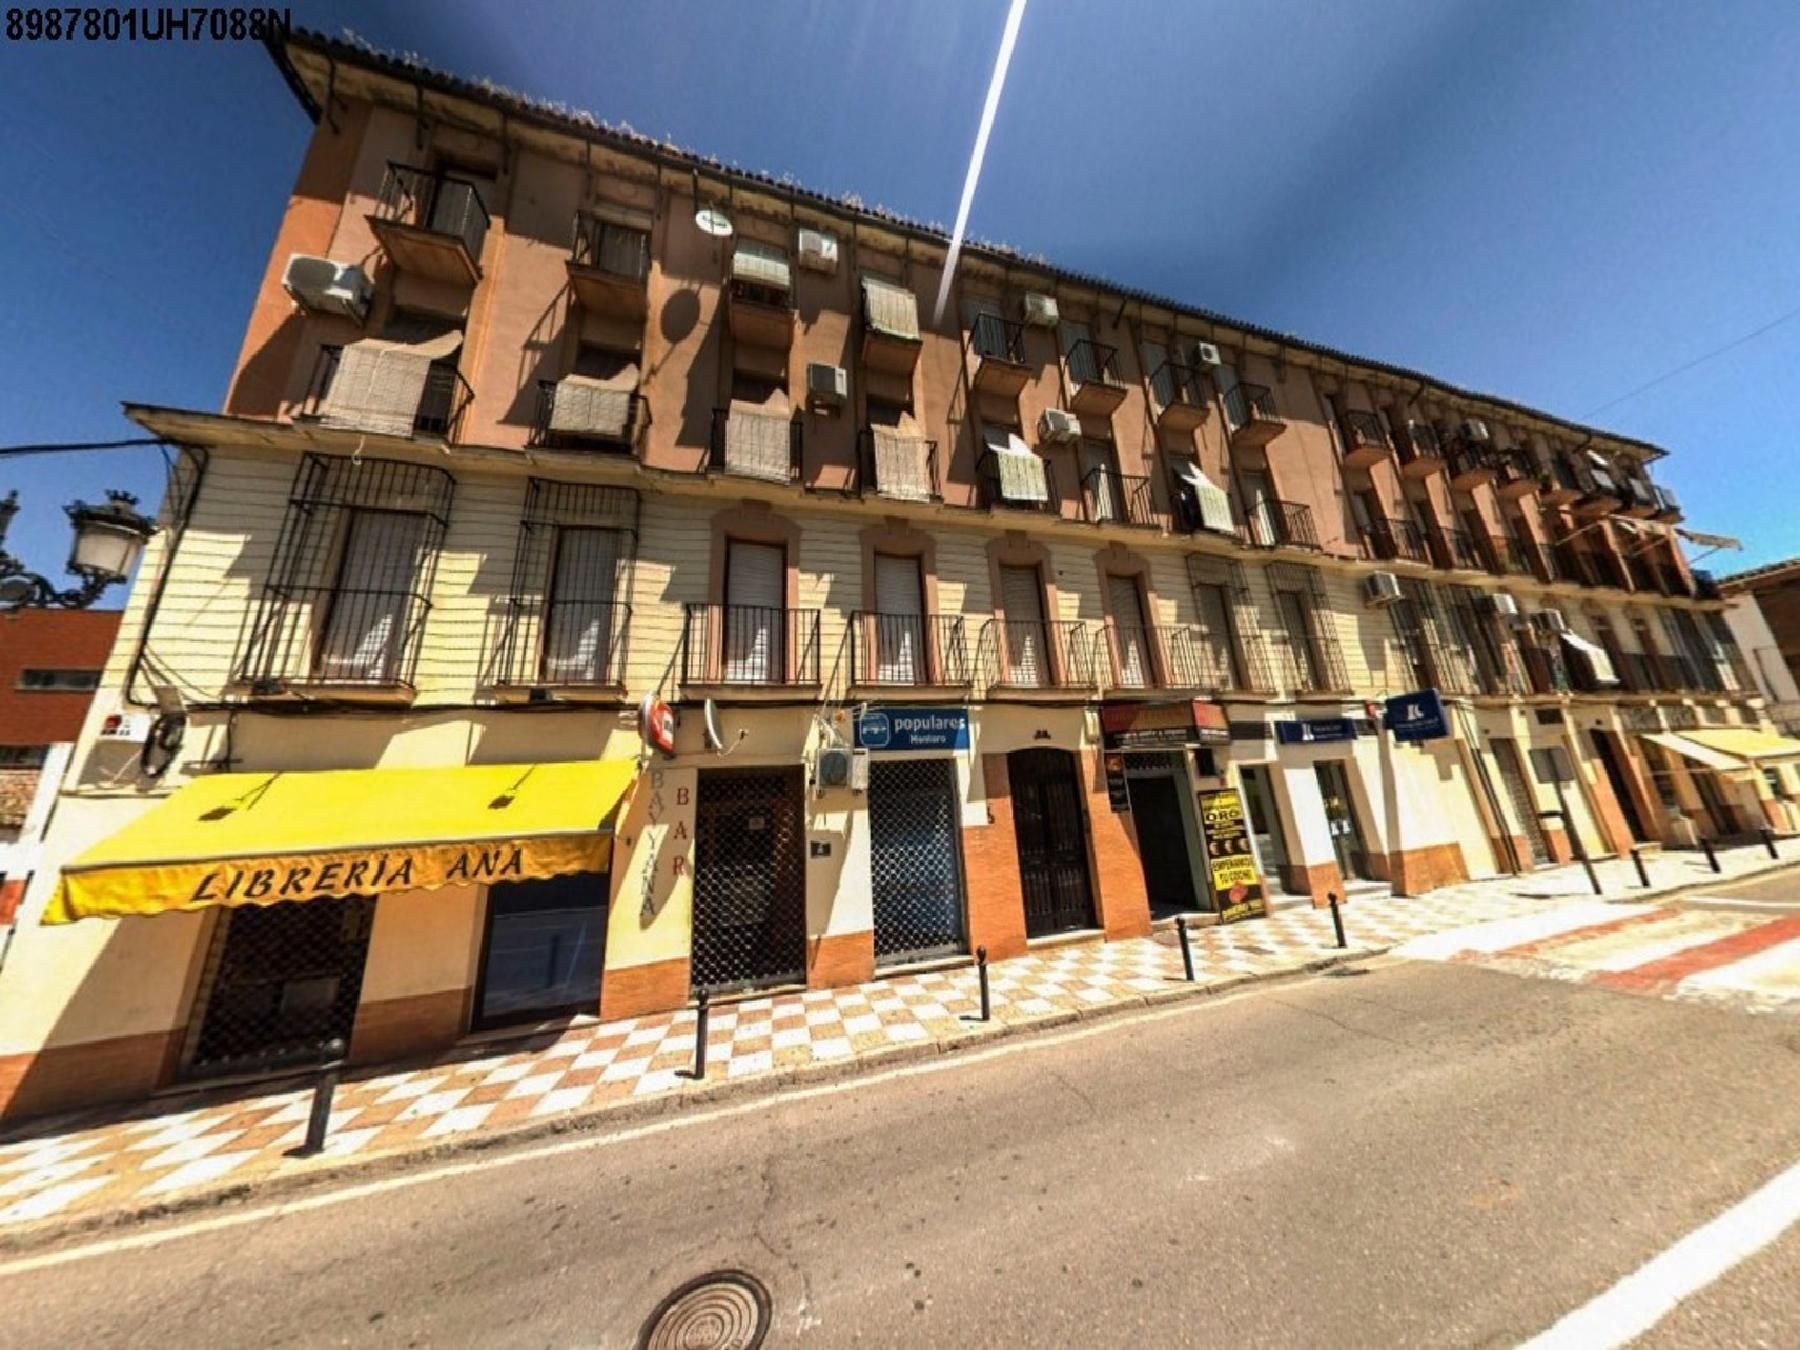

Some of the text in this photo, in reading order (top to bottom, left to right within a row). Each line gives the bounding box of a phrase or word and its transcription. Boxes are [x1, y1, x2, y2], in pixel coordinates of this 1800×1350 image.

[894, 714, 966, 733] populares
[673, 787, 689, 876] BAR
[447, 848, 522, 878] ANA
